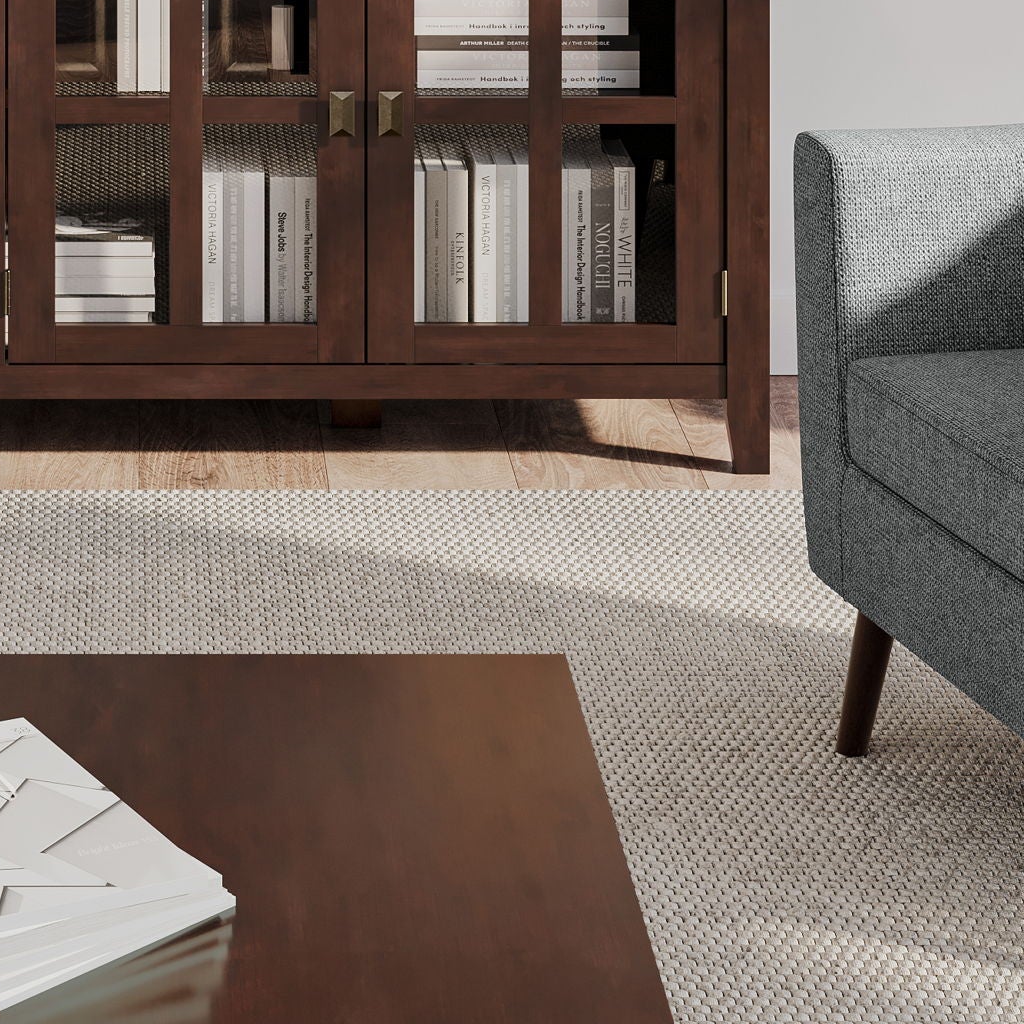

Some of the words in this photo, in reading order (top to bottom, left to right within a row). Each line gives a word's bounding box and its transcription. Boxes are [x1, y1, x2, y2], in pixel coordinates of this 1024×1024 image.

[208, 183, 217, 229] VICTORIA
[481, 175, 491, 219] VICTORIA
[277, 212, 287, 233] Steve
[576, 224, 586, 236] The
[208, 231, 217, 264] HAGAN
[277, 234, 287, 252] Jobs
[304, 233, 313, 245] The
[481, 222, 491, 256] HAGAN
[576, 237, 586, 261] Interior
[276, 253, 286, 263] by
[304, 246, 313, 271] Interior
[455, 232, 465, 284] KINFOLK
[595, 222, 611, 288] NOGUCHI
[617, 234, 632, 287] WHITE
[302, 271, 313, 294] Design
[574, 262, 586, 284] Design
[576, 286, 586, 321] Handbook
